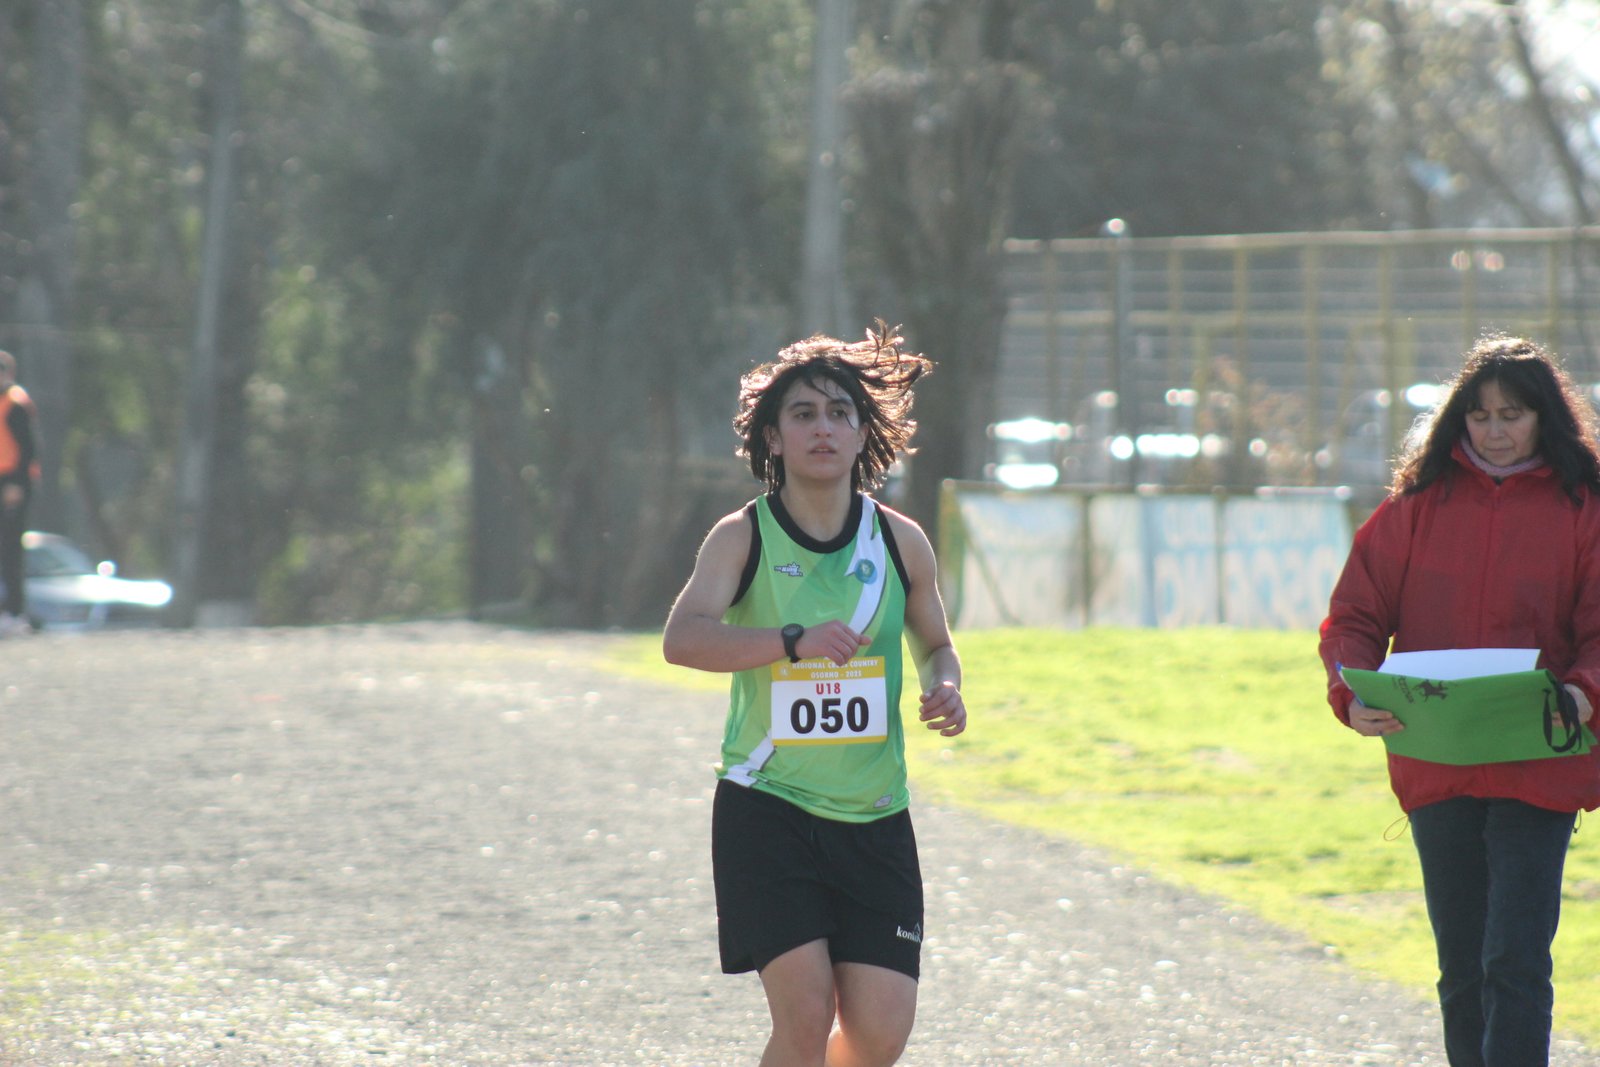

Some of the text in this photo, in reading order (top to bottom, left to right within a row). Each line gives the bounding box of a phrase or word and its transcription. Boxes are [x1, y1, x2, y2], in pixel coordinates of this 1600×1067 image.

[792, 661, 825, 669] REGIONAL
[850, 659, 878, 668] COUNTRY
[811, 671, 838, 679] OSORNO
[816, 683, 841, 695] U18
[790, 696, 869, 734] 050
